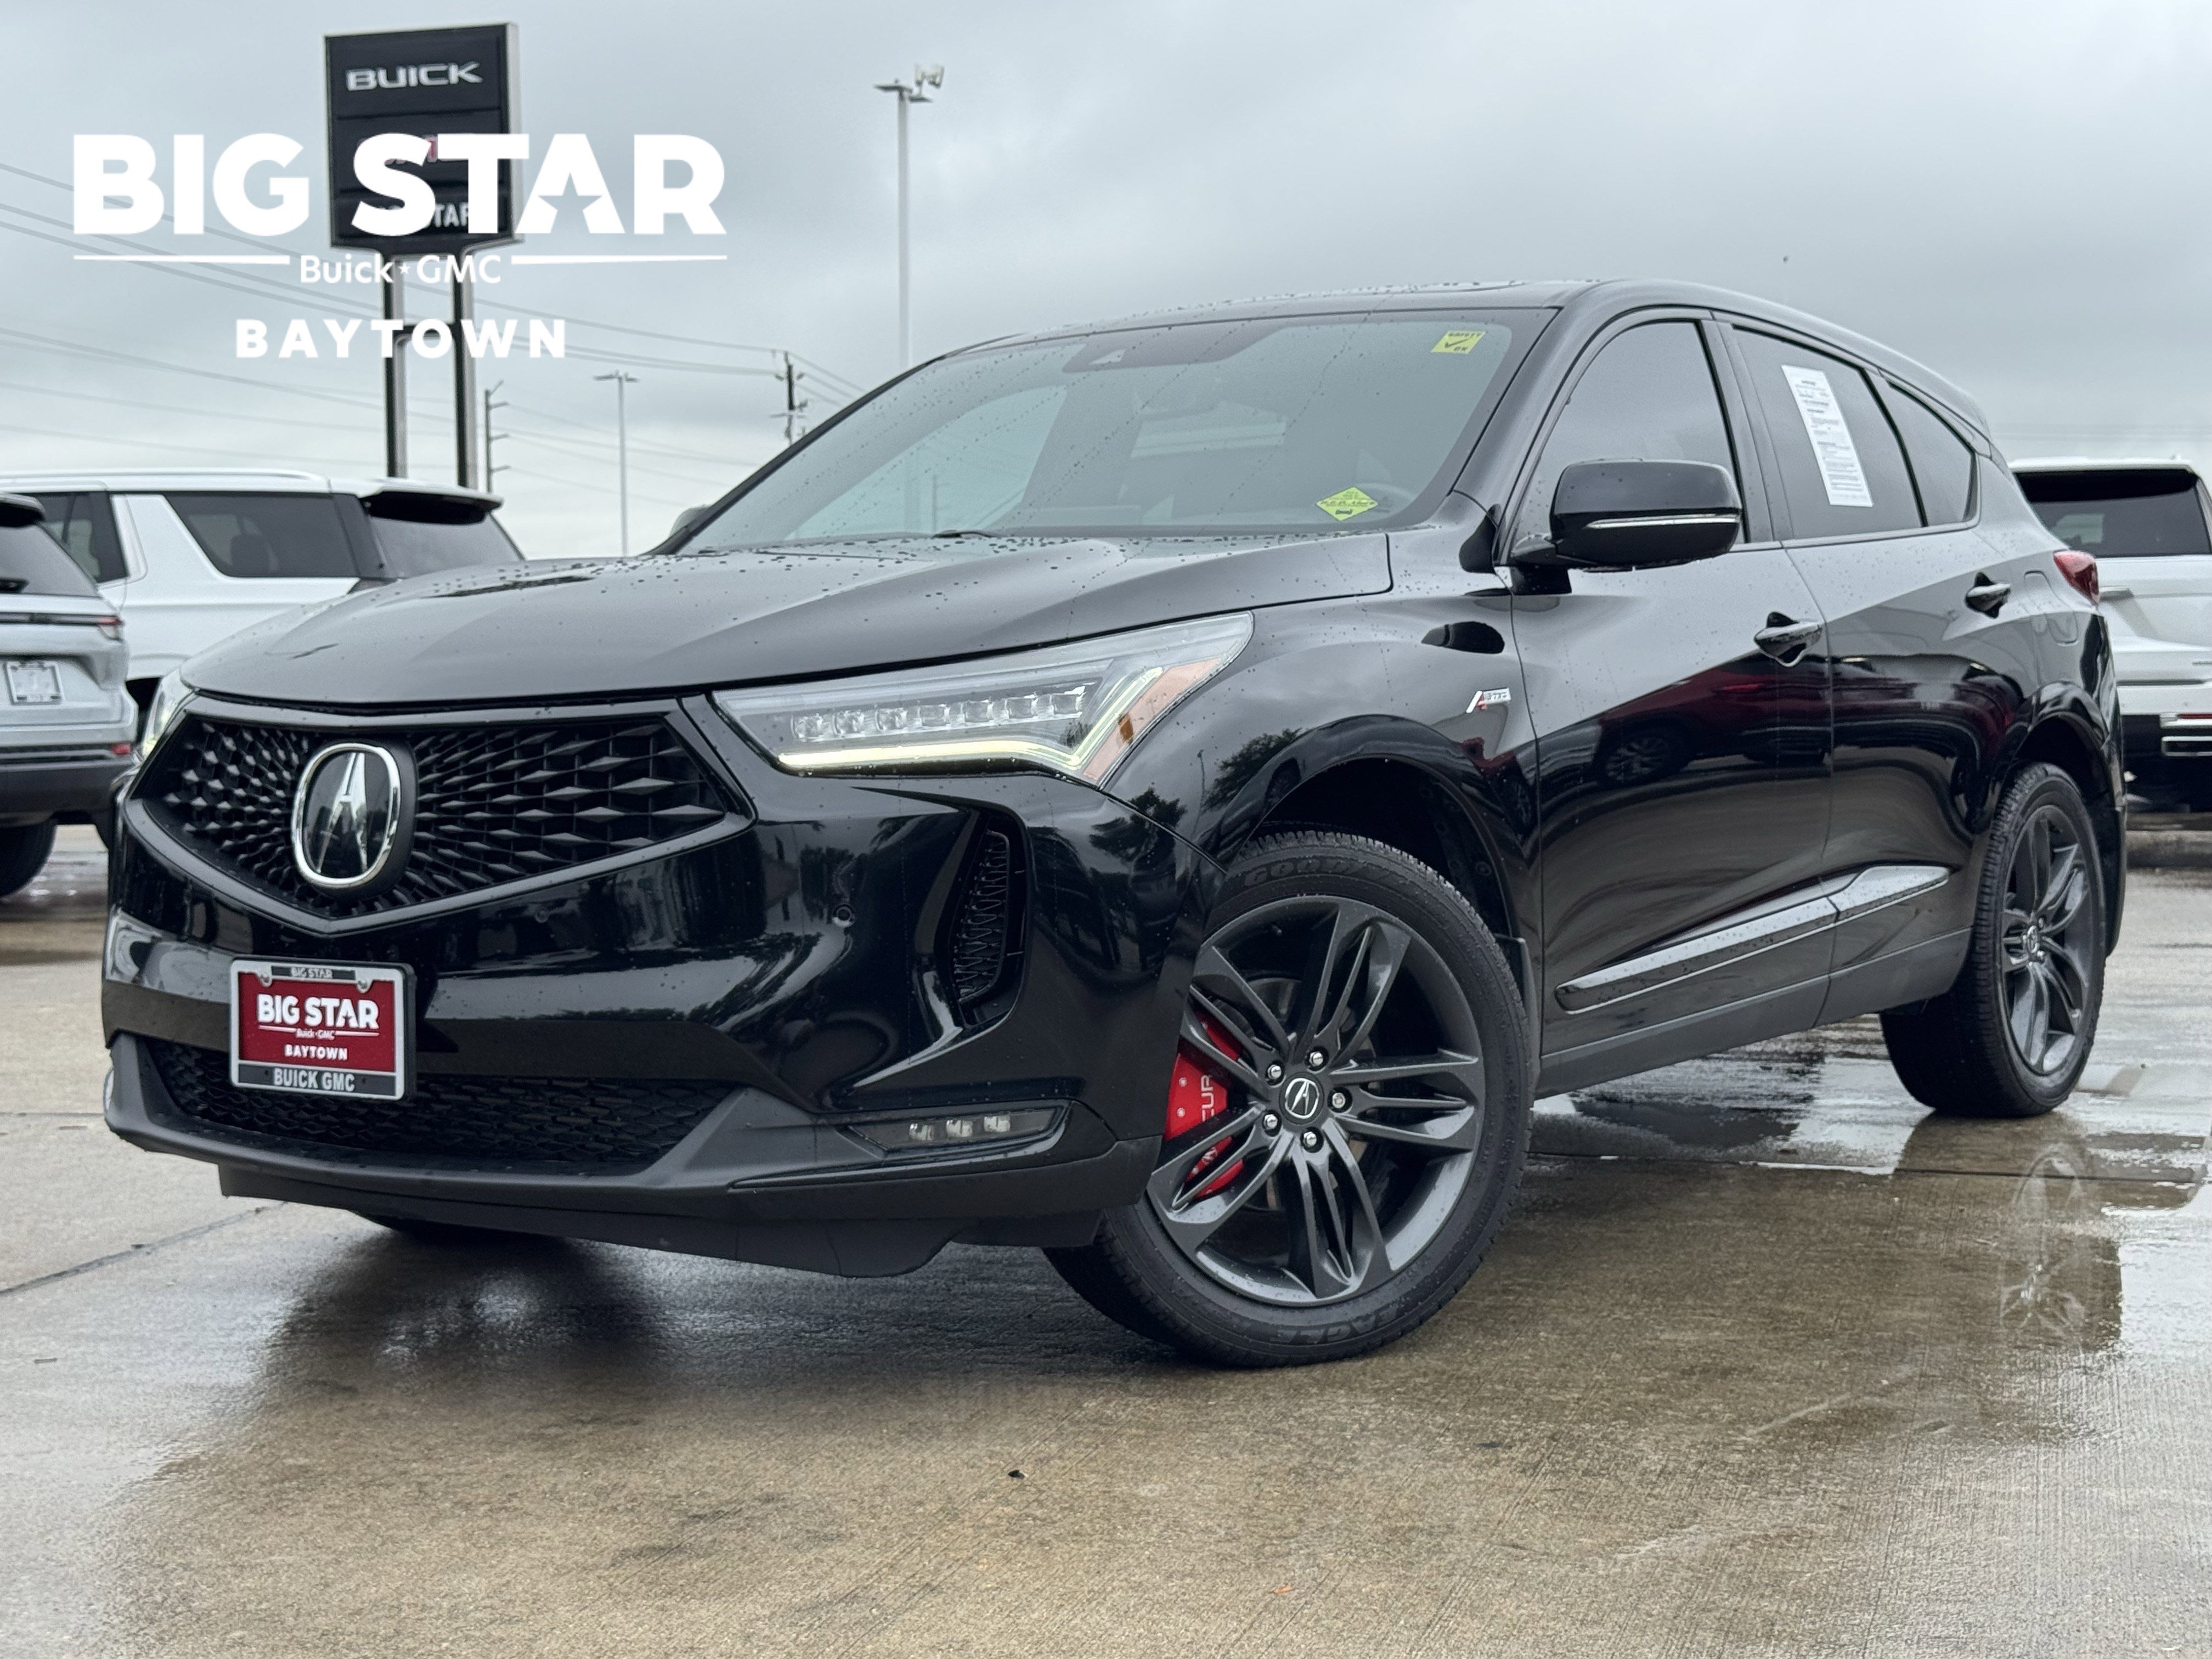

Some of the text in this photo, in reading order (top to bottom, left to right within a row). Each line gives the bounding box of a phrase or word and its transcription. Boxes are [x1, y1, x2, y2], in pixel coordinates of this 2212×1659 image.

[346, 61, 483, 91] BUICK
[291, 966, 333, 979] BIG STAR
[257, 994, 380, 1029] BIG STAR
[284, 1043, 348, 1060] BAYTOWN
[274, 1068, 356, 1092] BUICK GMC
